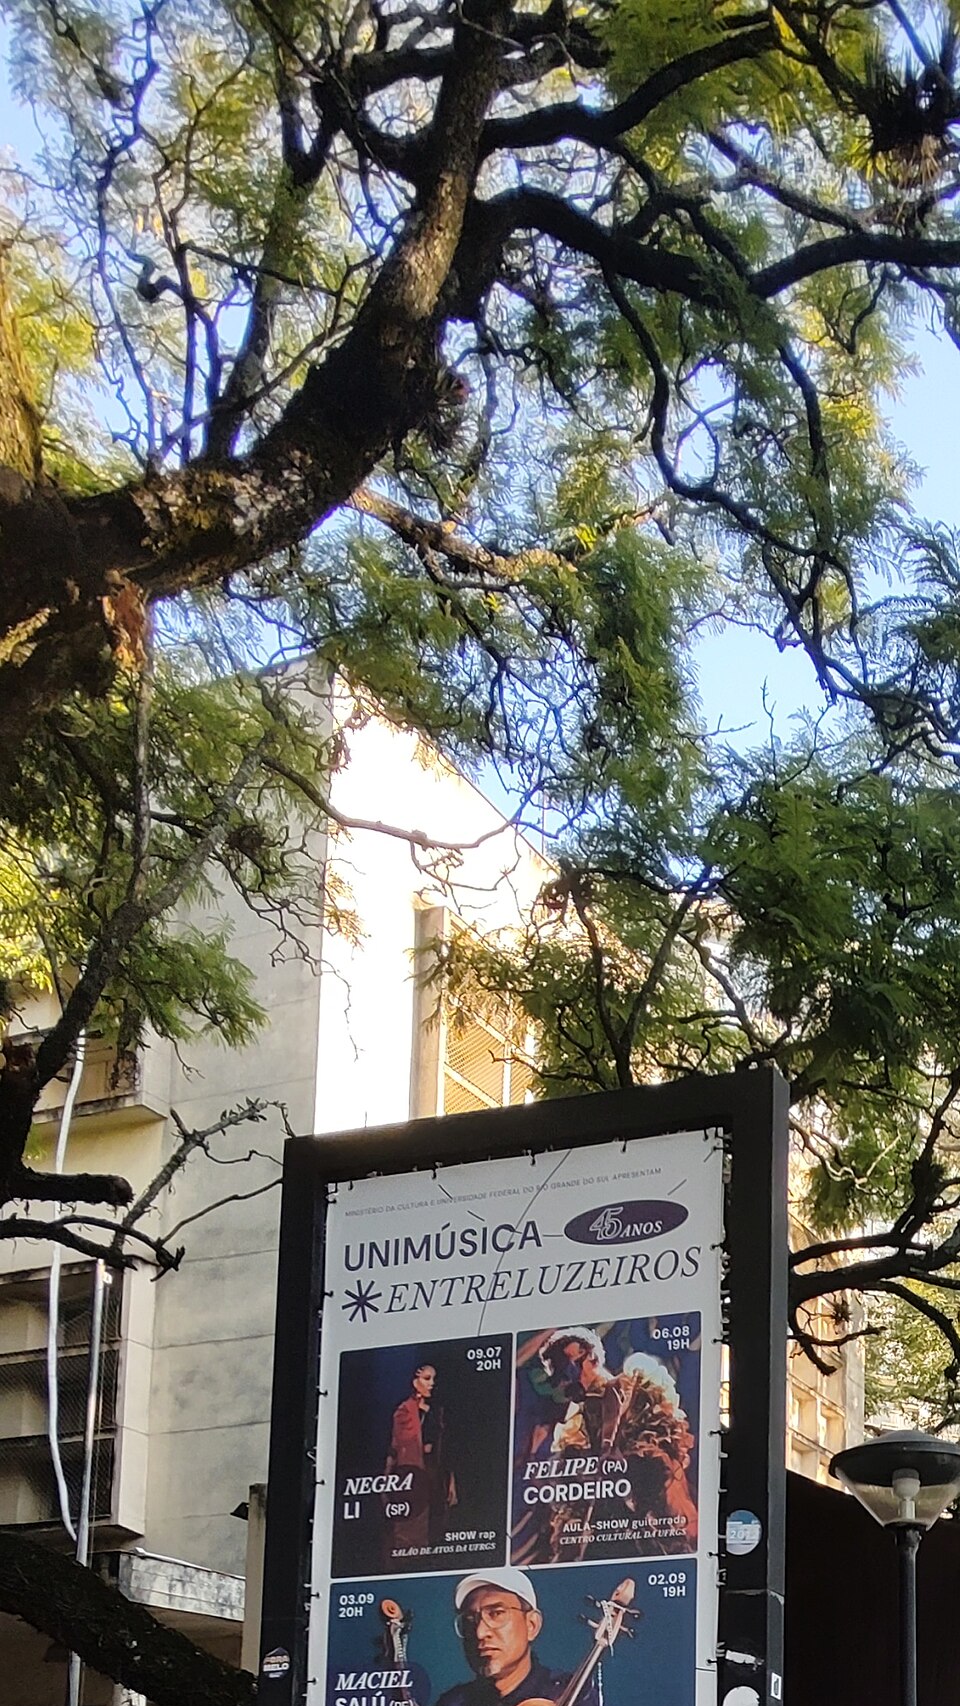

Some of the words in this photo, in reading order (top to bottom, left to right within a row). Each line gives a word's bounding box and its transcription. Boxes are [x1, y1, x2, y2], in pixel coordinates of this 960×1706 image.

[345, 1206, 384, 1217] MINISTÉRIO
[385, 1205, 395, 1213] DA
[397, 1201, 429, 1211] CULTURA
[437, 1192, 487, 1205] UNIVERSIDADE
[489, 1188, 520, 1198] FEDERAL
[523, 1185, 534, 1194] DO
[550, 1179, 580, 1189] GRANDE
[583, 1177, 594, 1185] DO
[596, 1175, 609, 1183] SUL
[612, 1167, 662, 1180] APRESENTAM
[589, 1206, 624, 1240] 45
[619, 1220, 663, 1238] ANOS
[344, 1220, 542, 1272] UNIMÚSICA
[384, 1246, 701, 1314] ENTRELUZEIROS
[652, 1325, 690, 1340] 06.08
[466, 1346, 502, 1360] 09.07
[667, 1338, 690, 1350] 19H
[476, 1359, 501, 1371] 20H
[522, 1456, 599, 1480] FELIPE
[602, 1458, 628, 1475] (PA)
[343, 1472, 414, 1496] NEGRA
[523, 1478, 632, 1505] CORDEIRO
[343, 1501, 360, 1519] LI
[385, 1502, 411, 1518] (SP)
[563, 1519, 629, 1533] AULA-SHOW
[632, 1515, 687, 1529] guitarrada
[445, 1531, 477, 1541] SHOW
[479, 1531, 496, 1541] rap
[560, 1535, 595, 1545] CENTRO
[596, 1532, 642, 1542] CULTURAL
[644, 1529, 656, 1539] DA
[657, 1527, 687, 1538] UFRGS
[391, 1547, 419, 1557] SALÃO
[420, 1546, 432, 1555] DE
[432, 1545, 454, 1554] ATOS
[455, 1544, 467, 1553] DA
[468, 1542, 496, 1551] UFRGS
[648, 1573, 686, 1586] 02.09
[339, 1593, 375, 1606] 03.09
[663, 1585, 686, 1598] 19H
[338, 1606, 363, 1618] 20H
[335, 1670, 414, 1691] MACIEL
